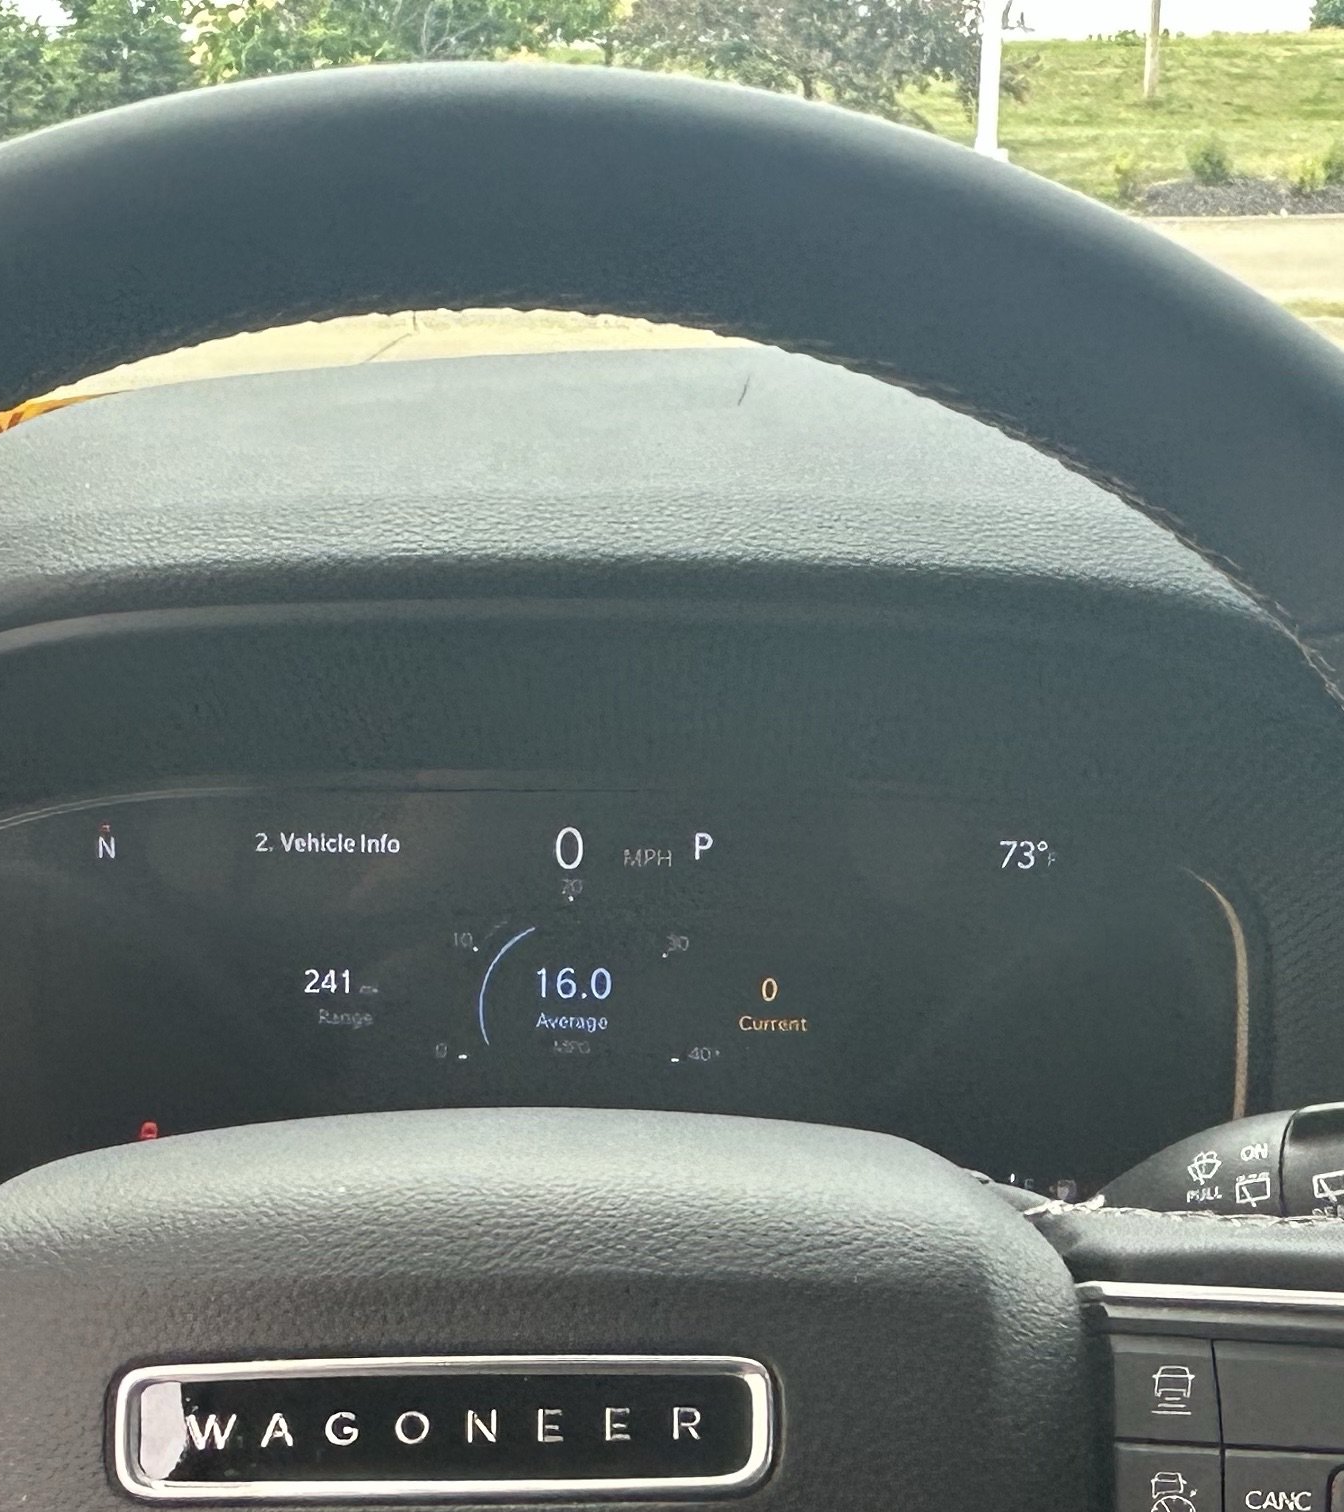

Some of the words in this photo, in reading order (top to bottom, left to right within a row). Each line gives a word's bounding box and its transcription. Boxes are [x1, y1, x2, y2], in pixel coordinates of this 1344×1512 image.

[97, 836, 116, 859] N
[255, 832, 273, 852] 2.
[280, 832, 356, 853] Vehicle
[360, 833, 401, 853] Info
[555, 826, 584, 870] 0
[623, 848, 672, 867] MPH
[694, 832, 714, 861] P
[453, 931, 474, 948] 10
[304, 968, 351, 994] 241
[536, 967, 613, 1000] 16.0
[761, 977, 778, 1002] 0
[318, 1008, 374, 1029] Range
[536, 1012, 609, 1034] Average
[738, 1015, 808, 1032] Current
[184, 1407, 702, 1450] WAGONEER
[1244, 1490, 1313, 1512] CANC
